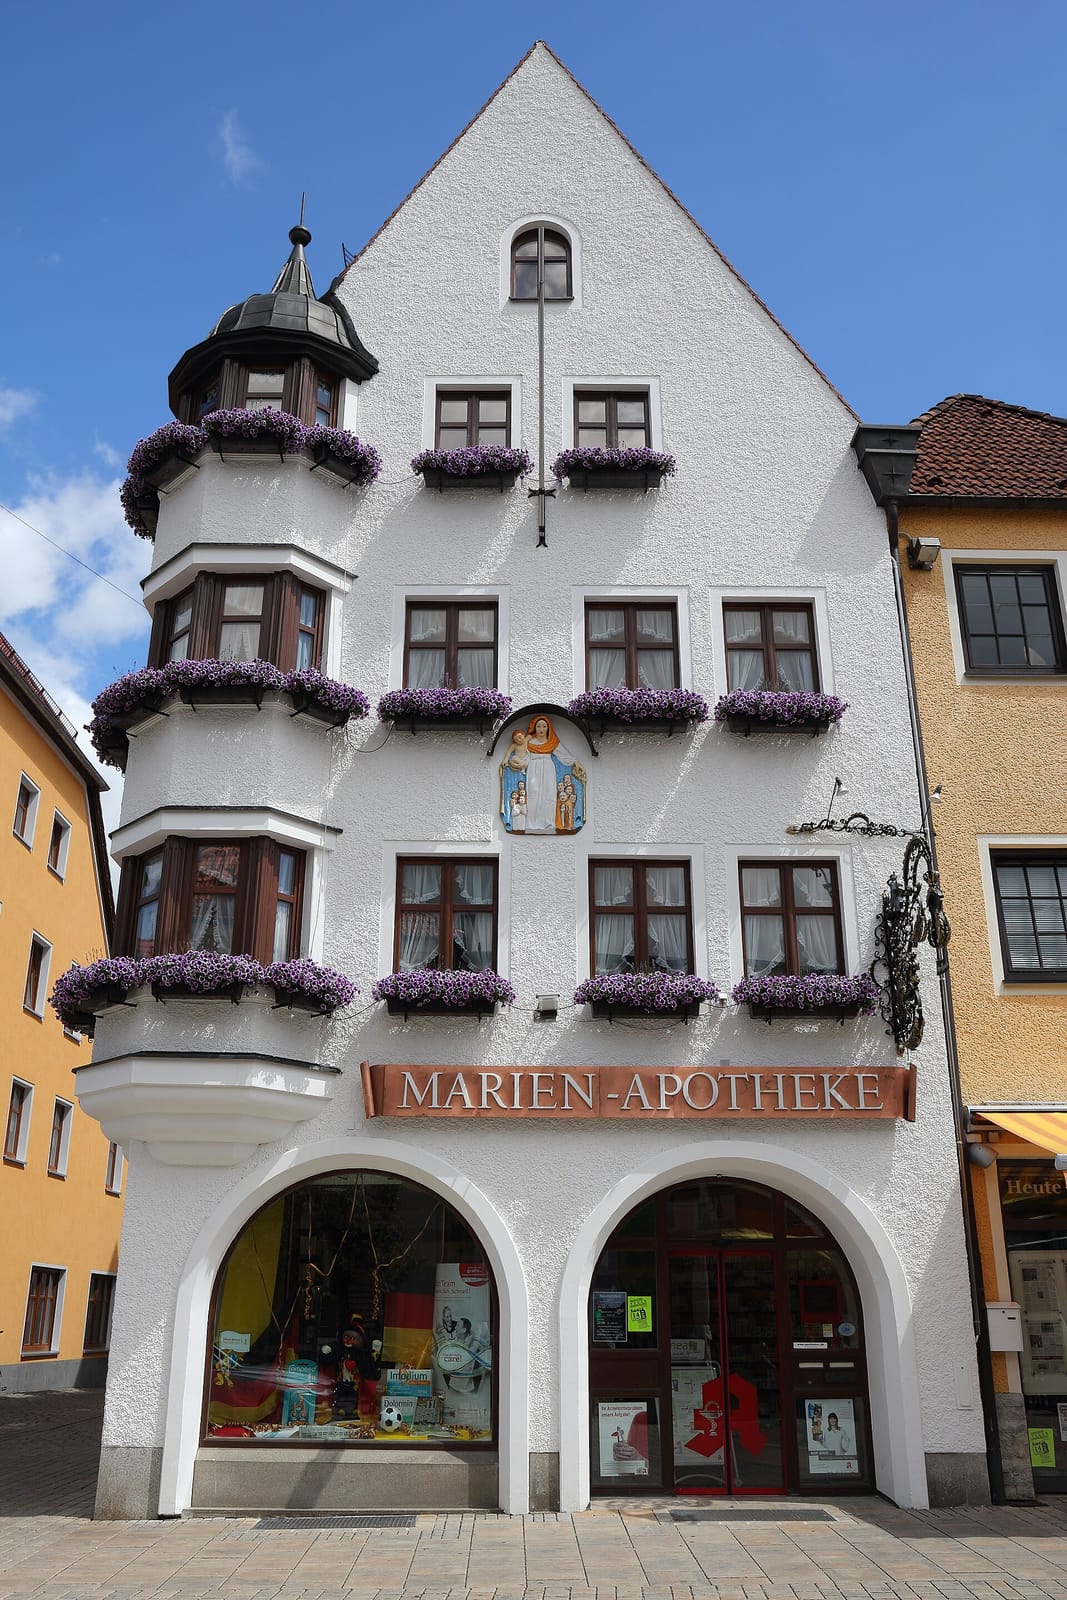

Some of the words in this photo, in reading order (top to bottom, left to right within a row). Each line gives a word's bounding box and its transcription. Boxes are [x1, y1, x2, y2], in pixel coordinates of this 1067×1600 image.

[397, 1071, 596, 1110] MARIEN
[1007, 1180, 1062, 1194] Heute
[390, 1371, 428, 1380] Imodium
